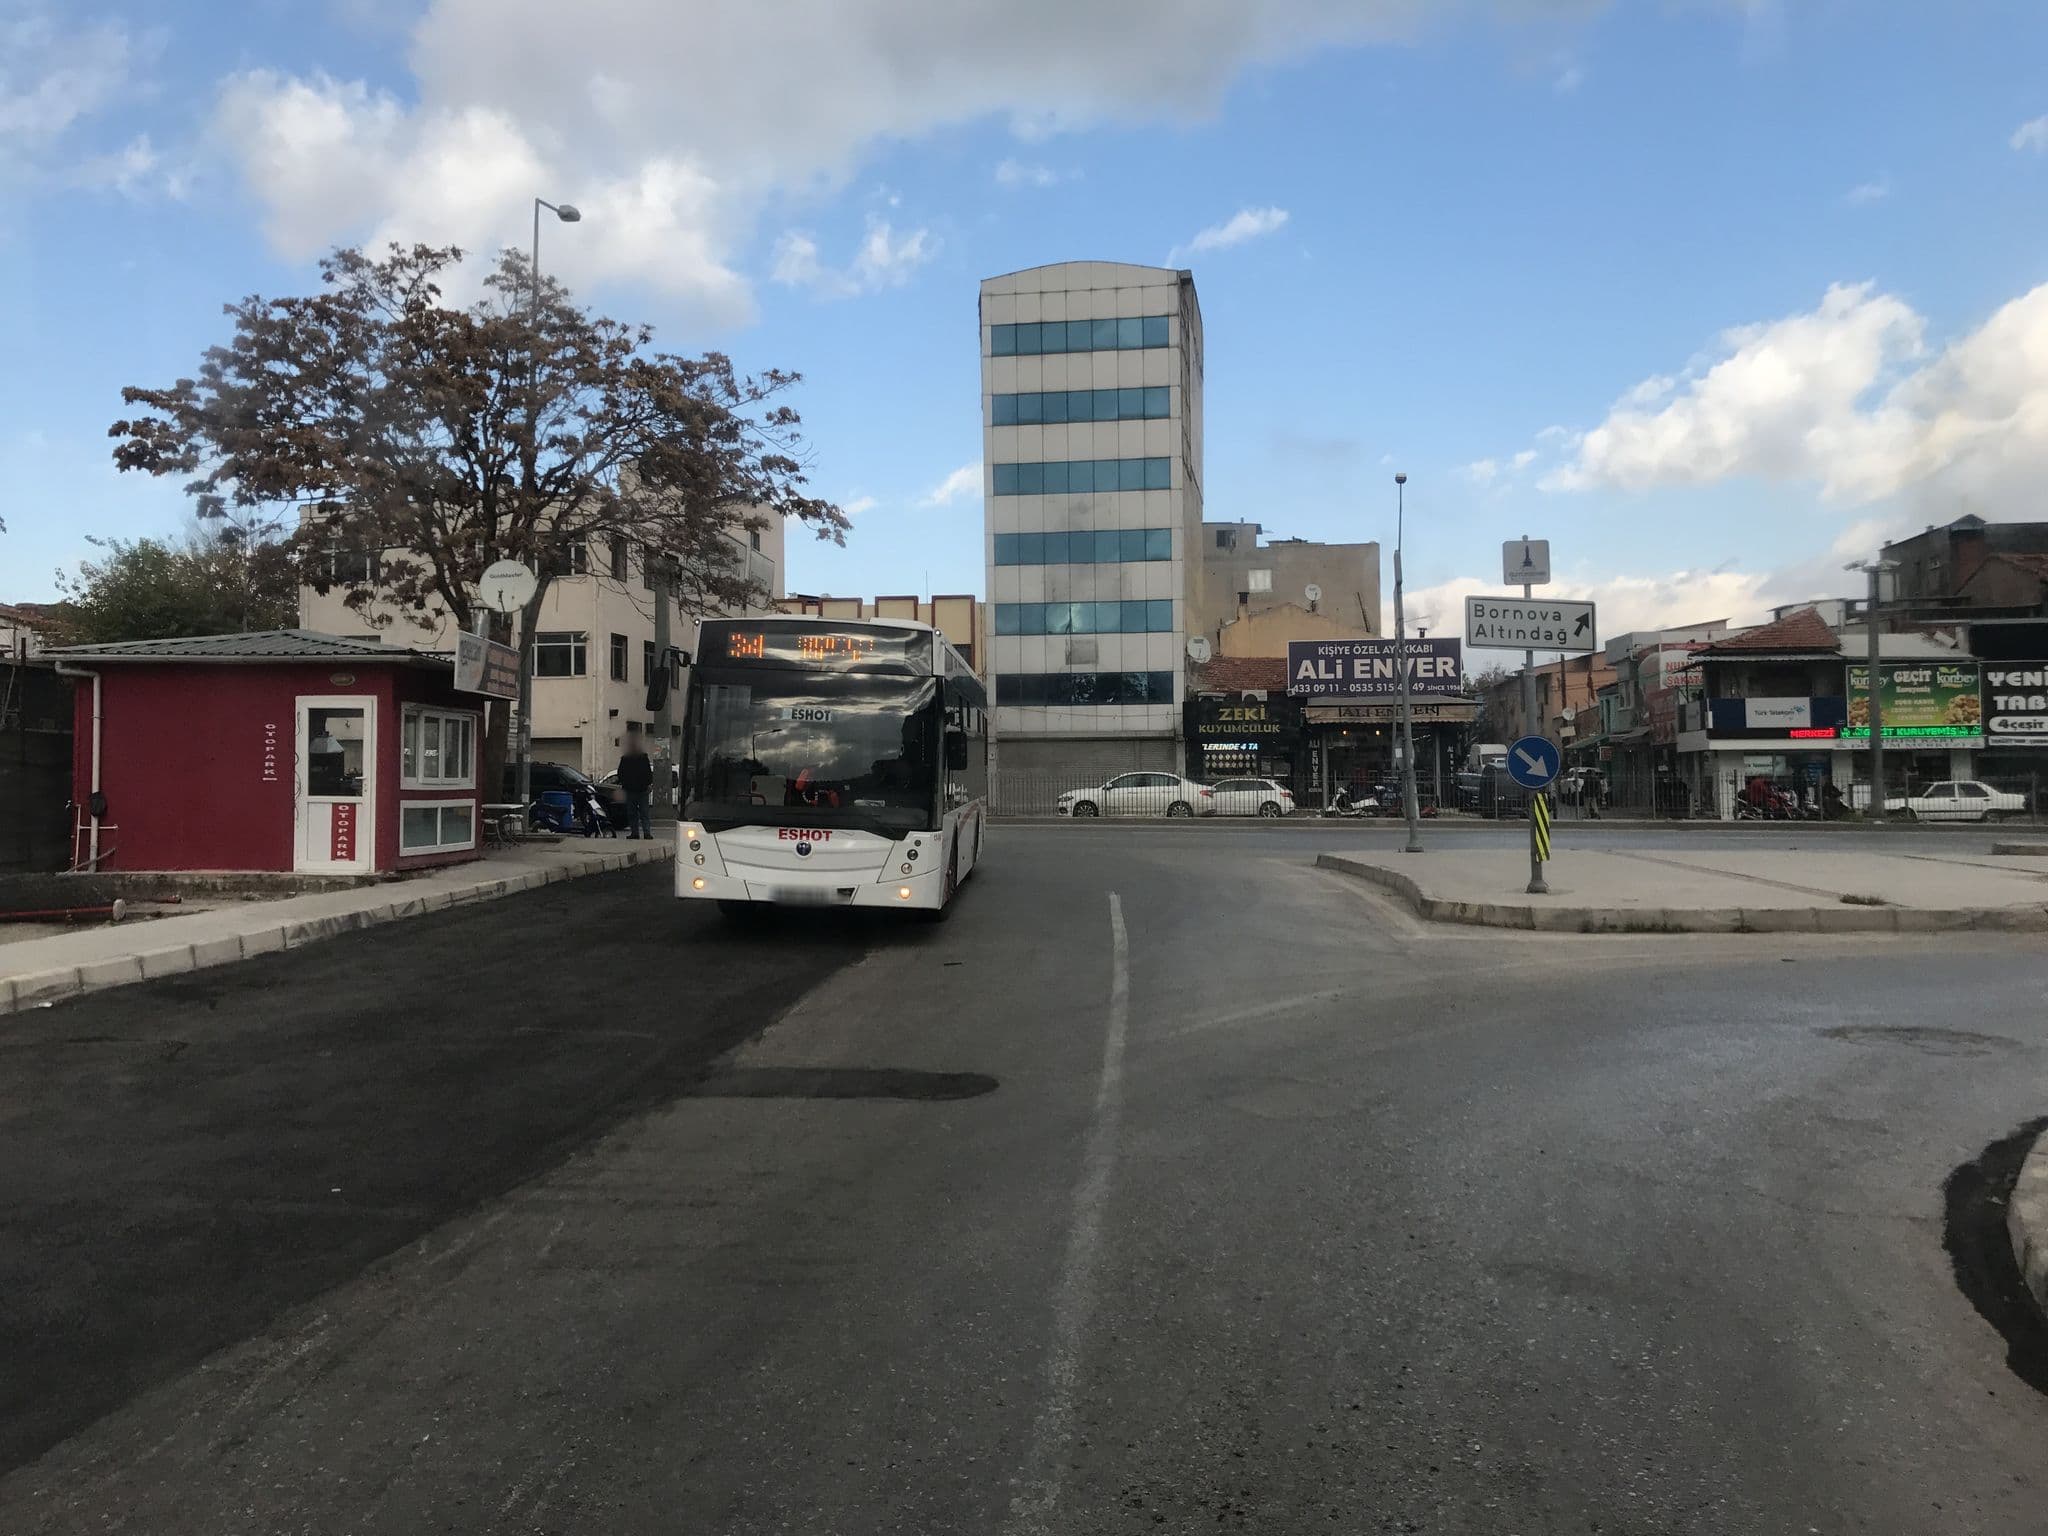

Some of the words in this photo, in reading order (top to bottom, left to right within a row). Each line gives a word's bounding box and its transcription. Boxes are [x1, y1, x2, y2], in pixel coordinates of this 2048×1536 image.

[1474, 604, 1562, 621] Bornova
[1475, 624, 1567, 645] Altındağ
[1318, 644, 1350, 657] KİŞİYE
[1353, 644, 1380, 655] ÖZEL
[1382, 644, 1433, 655] AYKKABI
[1353, 656, 1457, 679] ENVER
[1893, 668, 1932, 685] GEÇİT
[1313, 684, 1325, 693] 09
[1329, 684, 1339, 693] 11
[1349, 683, 1374, 693] 0535
[1376, 683, 1394, 693] 515
[1412, 683, 1424, 692] 49
[791, 709, 831, 722] ESHOT
[1219, 704, 1266, 721] ZEKİ
[1199, 724, 1280, 733] KUYUMCULUK
[264, 723, 276, 775] OTOPARK
[337, 804, 349, 857] OTOPARK
[778, 828, 832, 841] ESHOT
